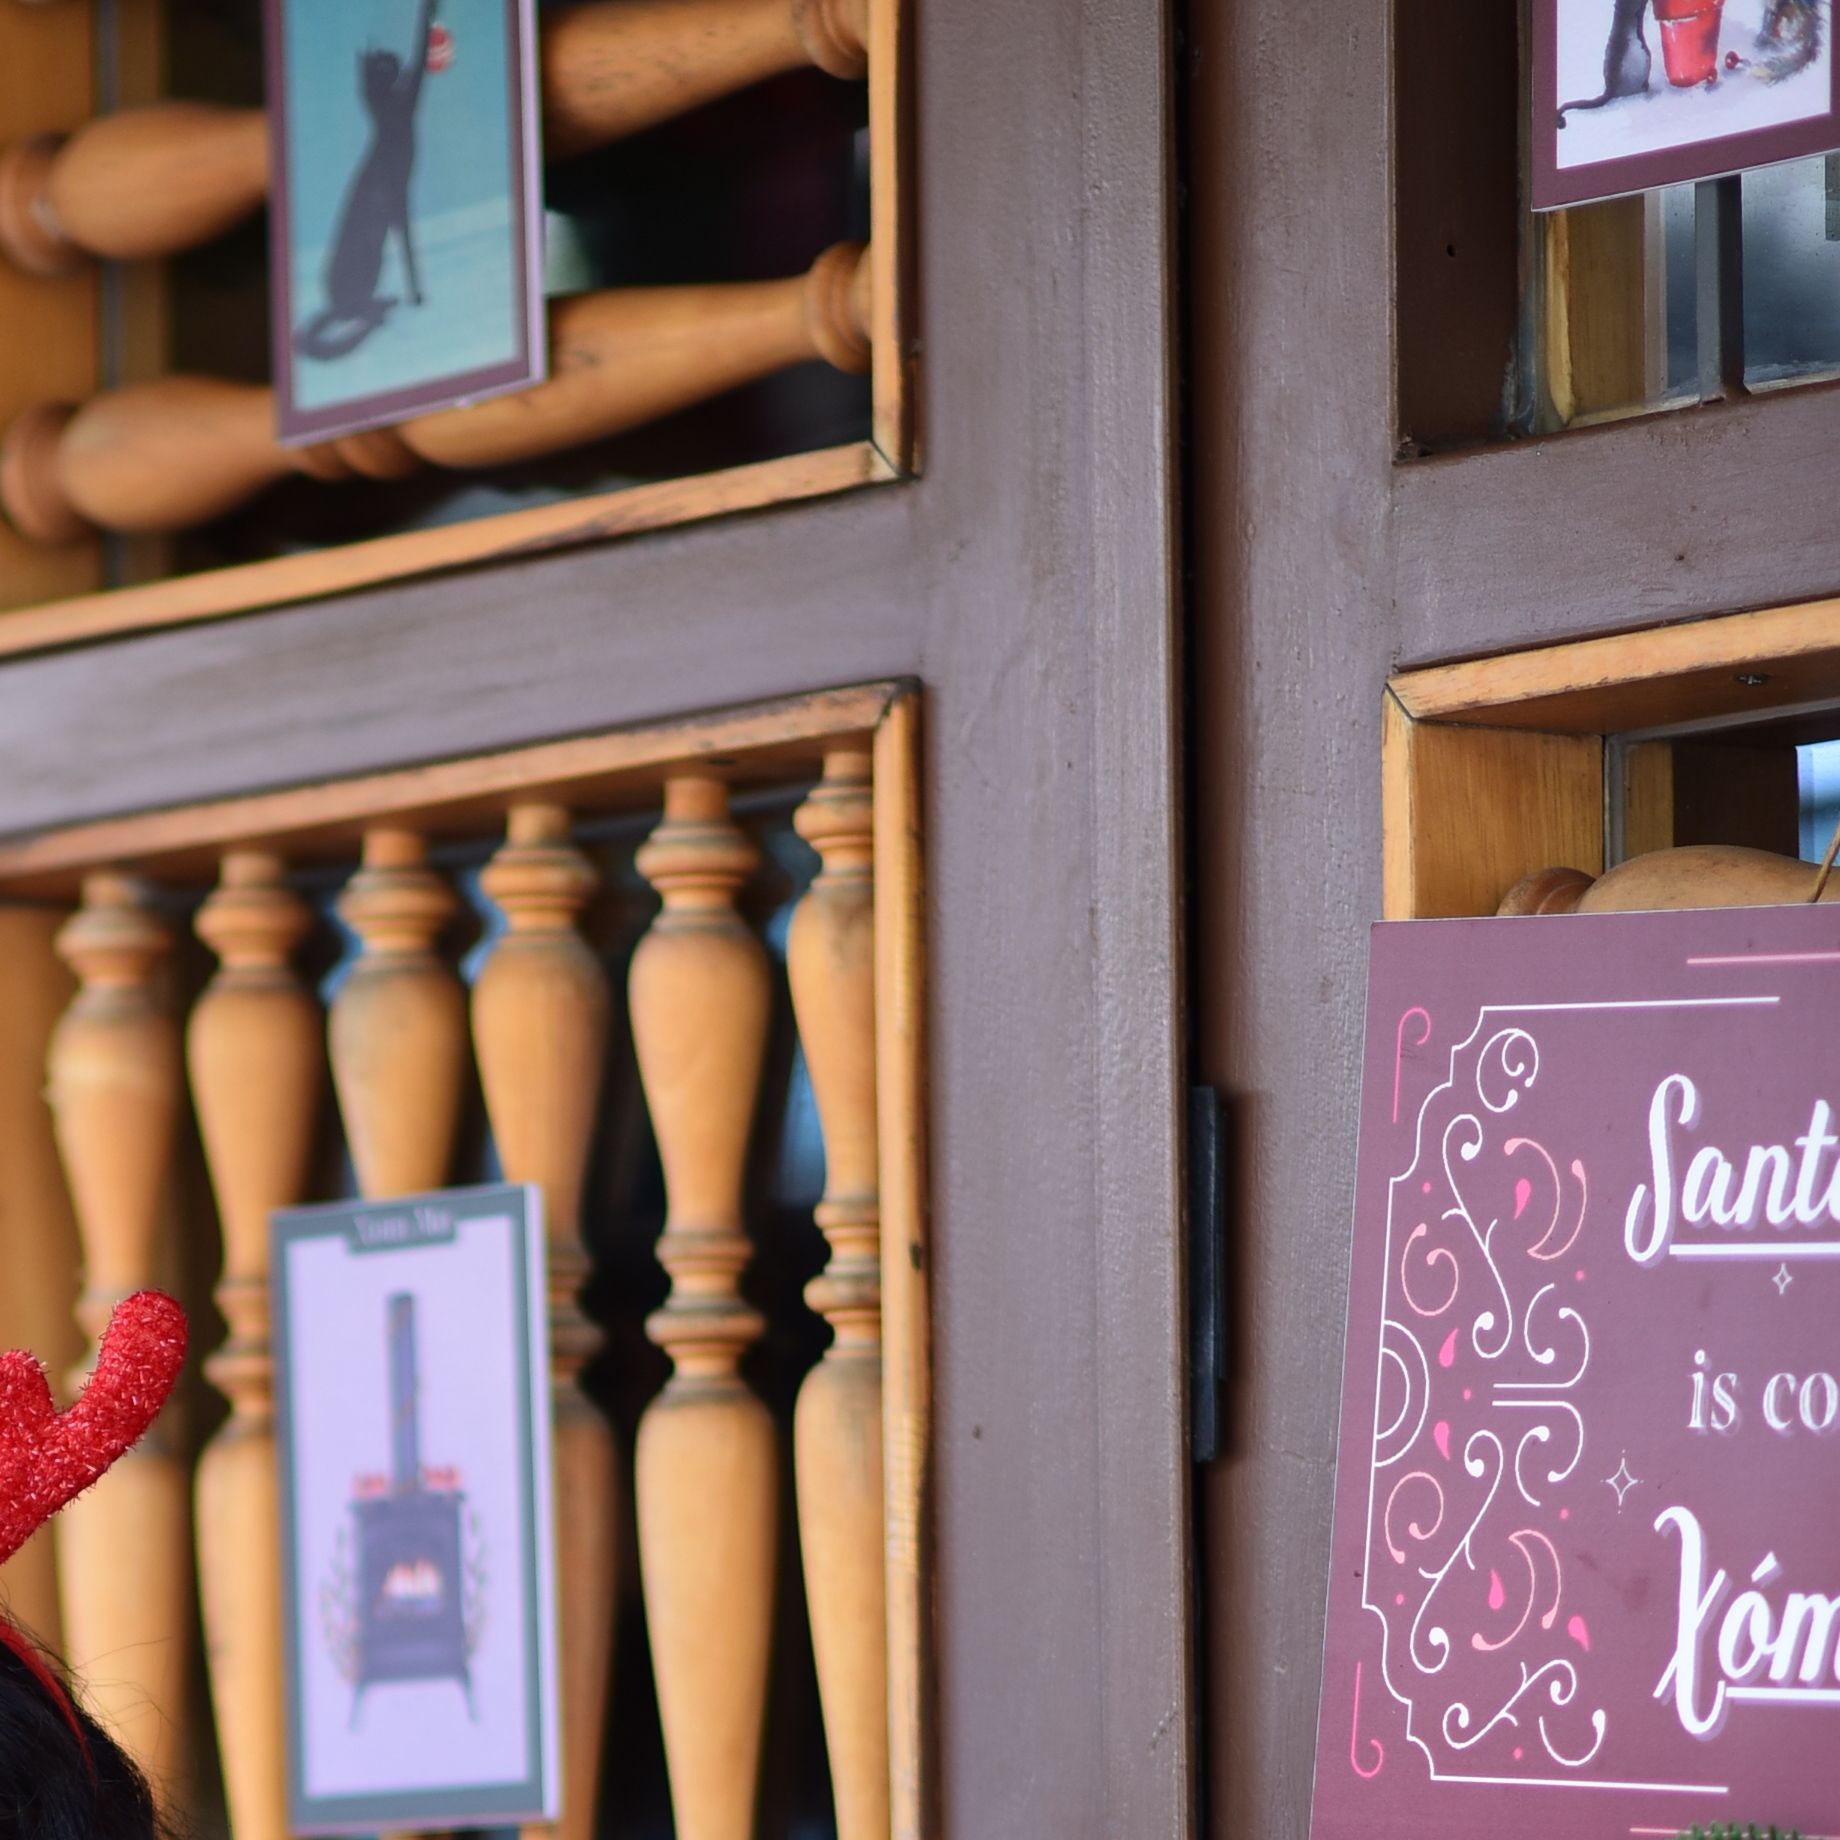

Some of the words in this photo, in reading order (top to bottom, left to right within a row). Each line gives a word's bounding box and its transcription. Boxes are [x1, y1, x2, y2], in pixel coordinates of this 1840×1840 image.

[1624, 1073, 1840, 1264] Sant
[1686, 1349, 1738, 1430] is
[1653, 1505, 1840, 1735] Xóm
